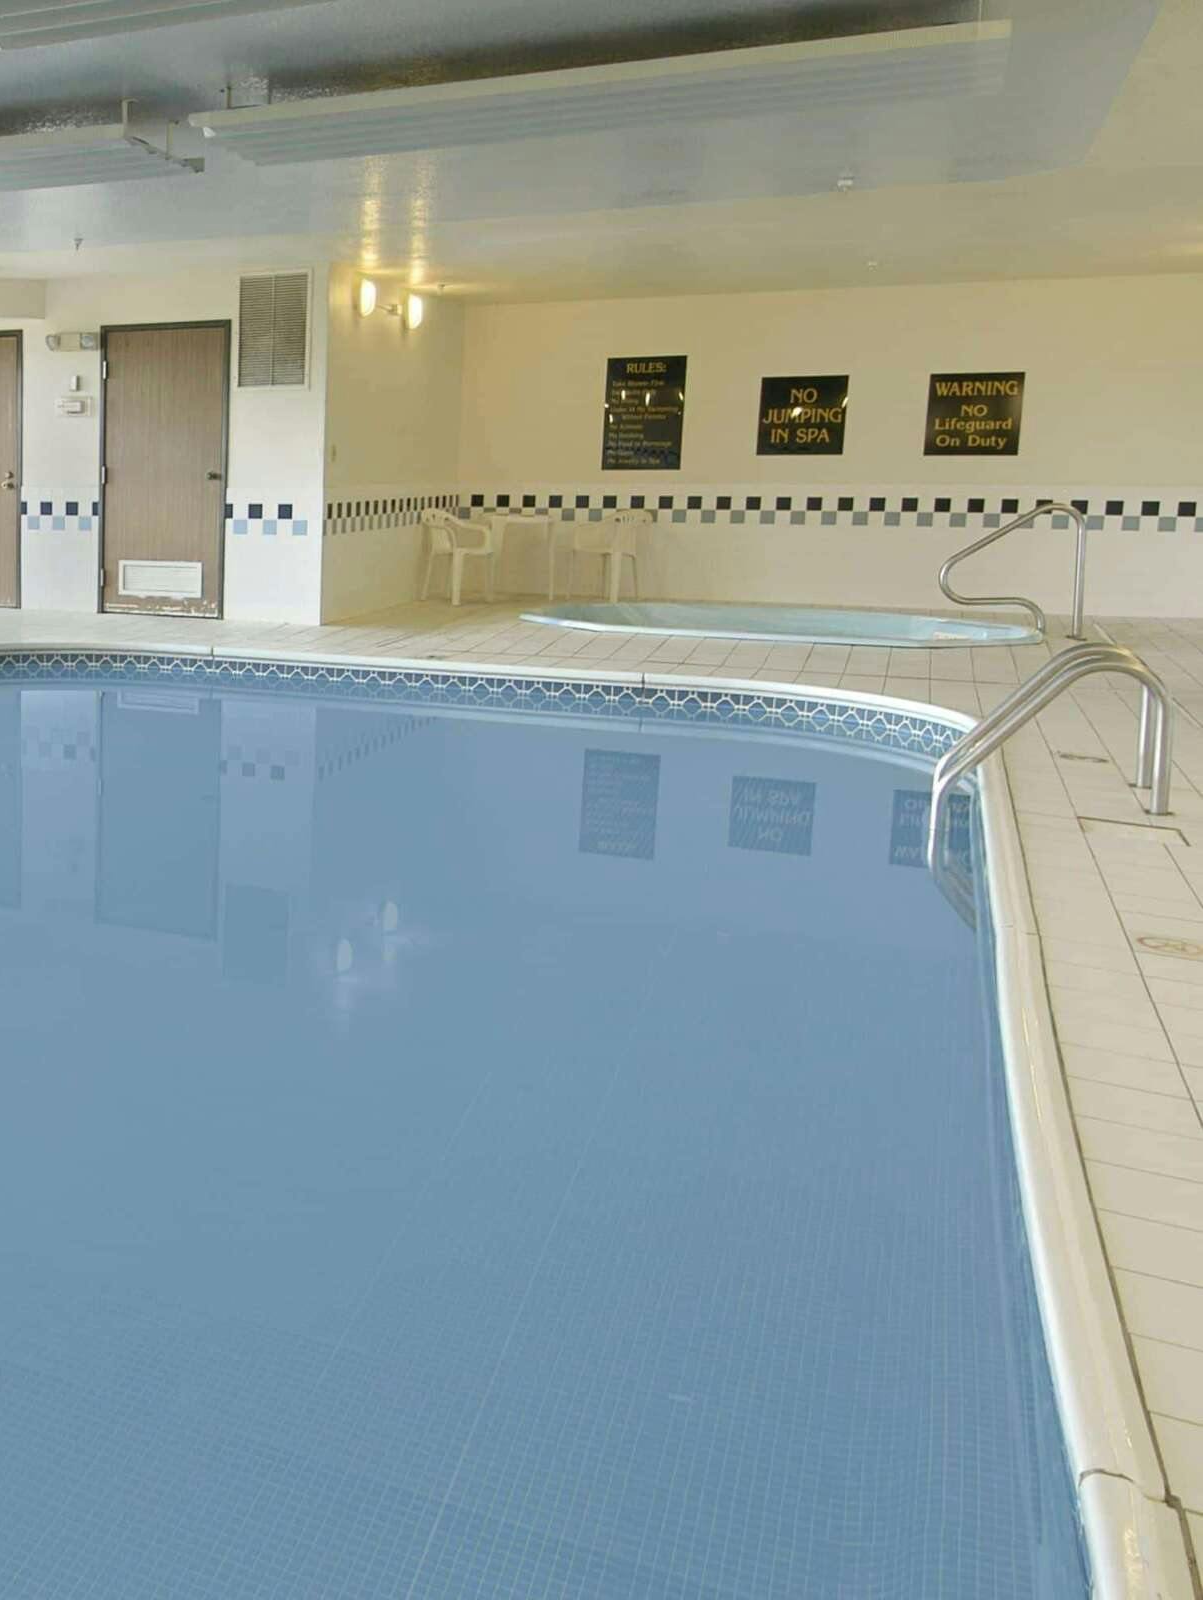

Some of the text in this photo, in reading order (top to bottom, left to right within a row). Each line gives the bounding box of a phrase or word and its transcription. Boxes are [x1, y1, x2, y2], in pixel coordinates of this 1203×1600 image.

[626, 361, 667, 374] RULES:
[935, 380, 1019, 396] WARNING
[790, 388, 817, 404] NO
[763, 407, 843, 424] JUMPING
[961, 404, 988, 417] NO
[934, 418, 1013, 433] Lifeguard
[770, 428, 830, 443] IN SPA
[935, 434, 1007, 450] On Duty
